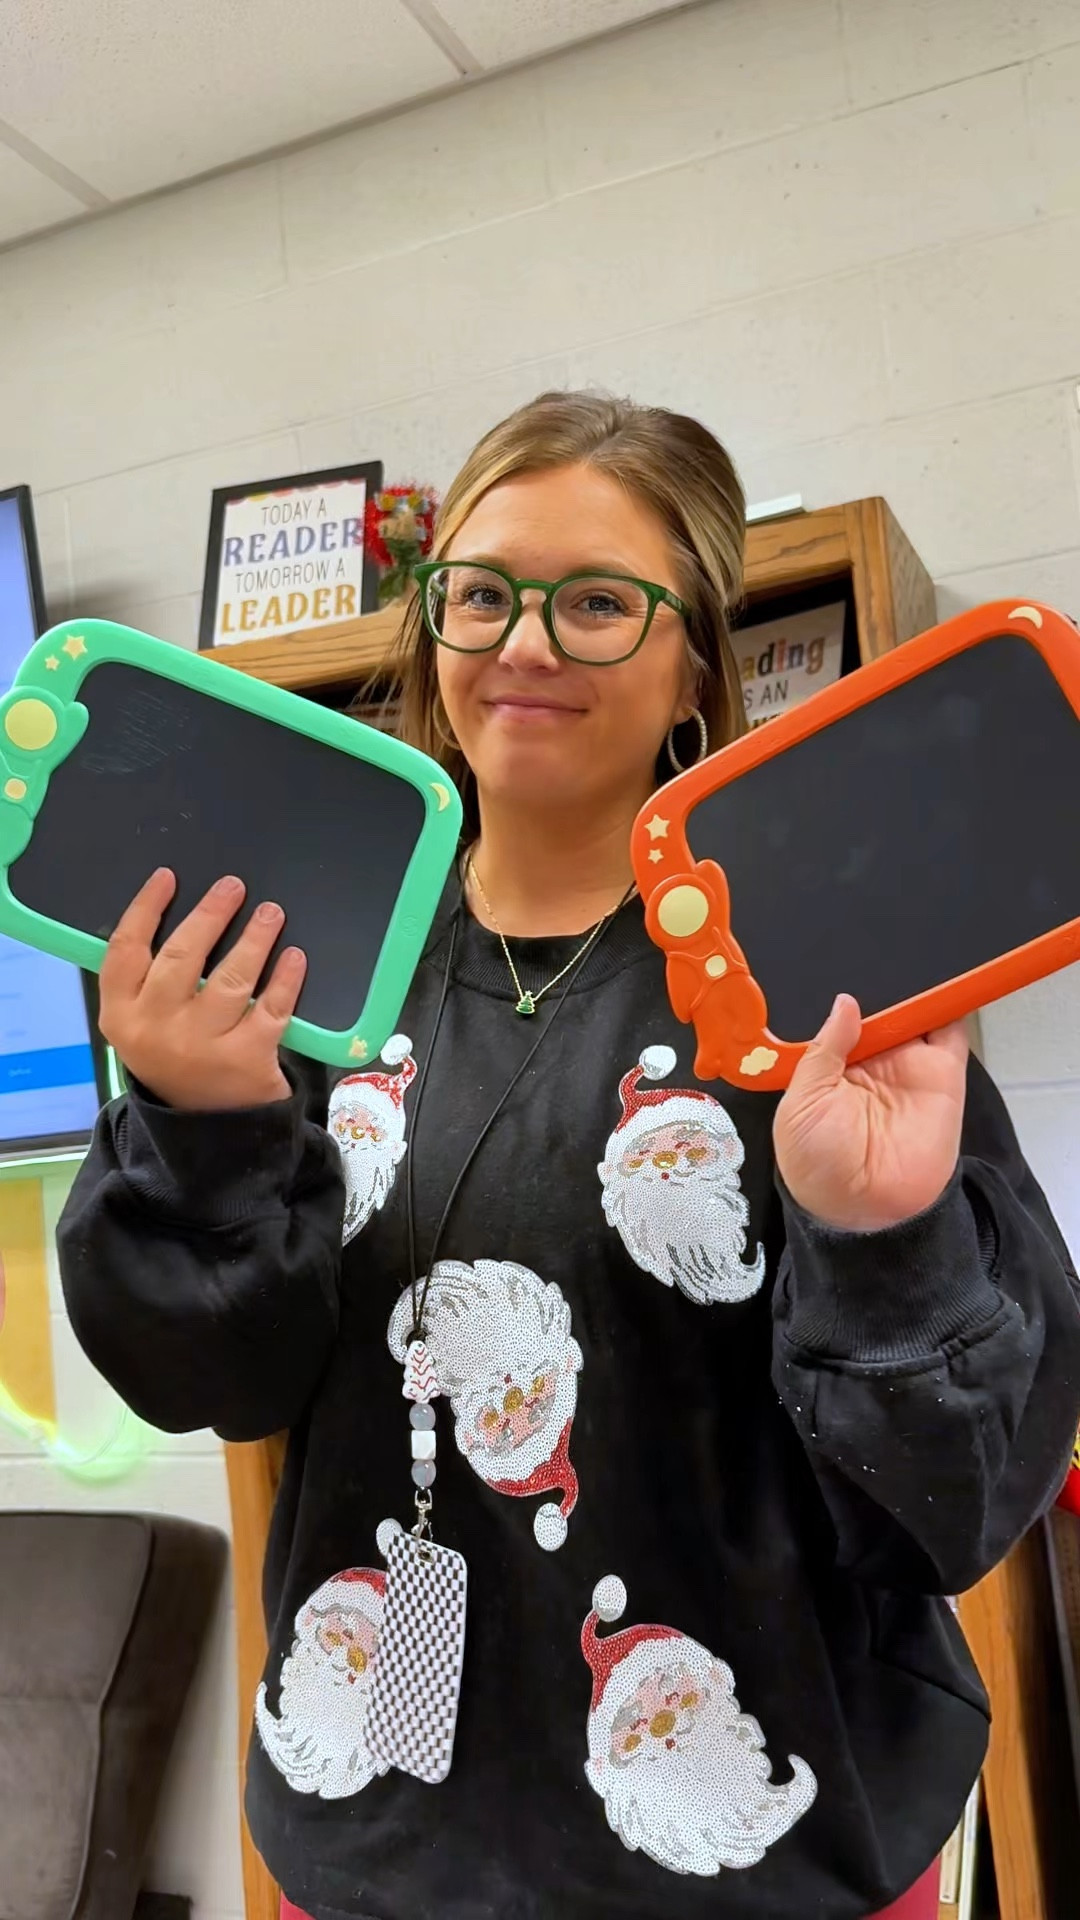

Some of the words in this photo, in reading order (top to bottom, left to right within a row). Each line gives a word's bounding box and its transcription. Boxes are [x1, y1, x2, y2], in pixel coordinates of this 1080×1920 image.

[261, 500, 313, 525] TODAY
[317, 498, 327, 517] A
[224, 517, 363, 566] READER
[236, 561, 330, 593] TOMORROW
[336, 557, 346, 578] A
[222, 584, 356, 633] LEADER
[743, 637, 825, 680] ading
[761, 680, 788, 706] AN
